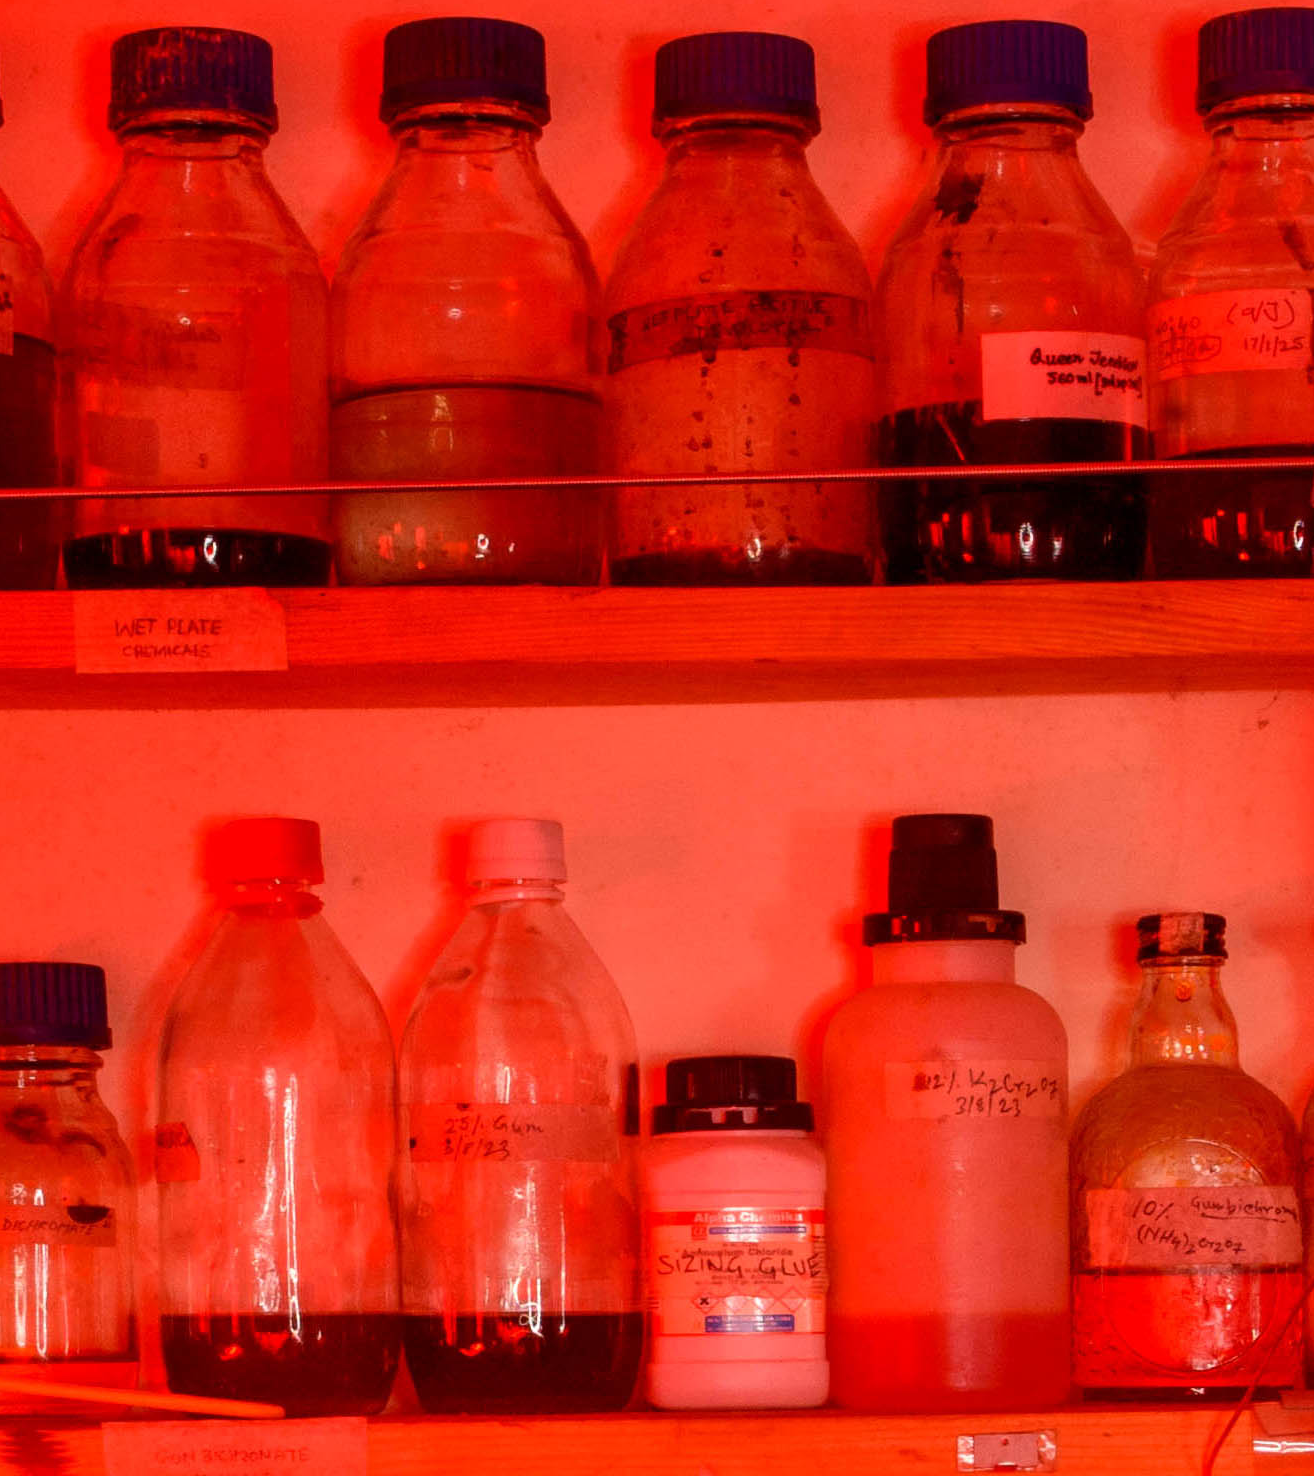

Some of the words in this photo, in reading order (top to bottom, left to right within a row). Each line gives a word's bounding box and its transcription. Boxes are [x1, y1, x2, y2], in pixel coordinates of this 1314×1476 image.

[114, 617, 159, 639] WET
[166, 617, 223, 637] PLATE
[758, 1252, 823, 1281] GLUE
